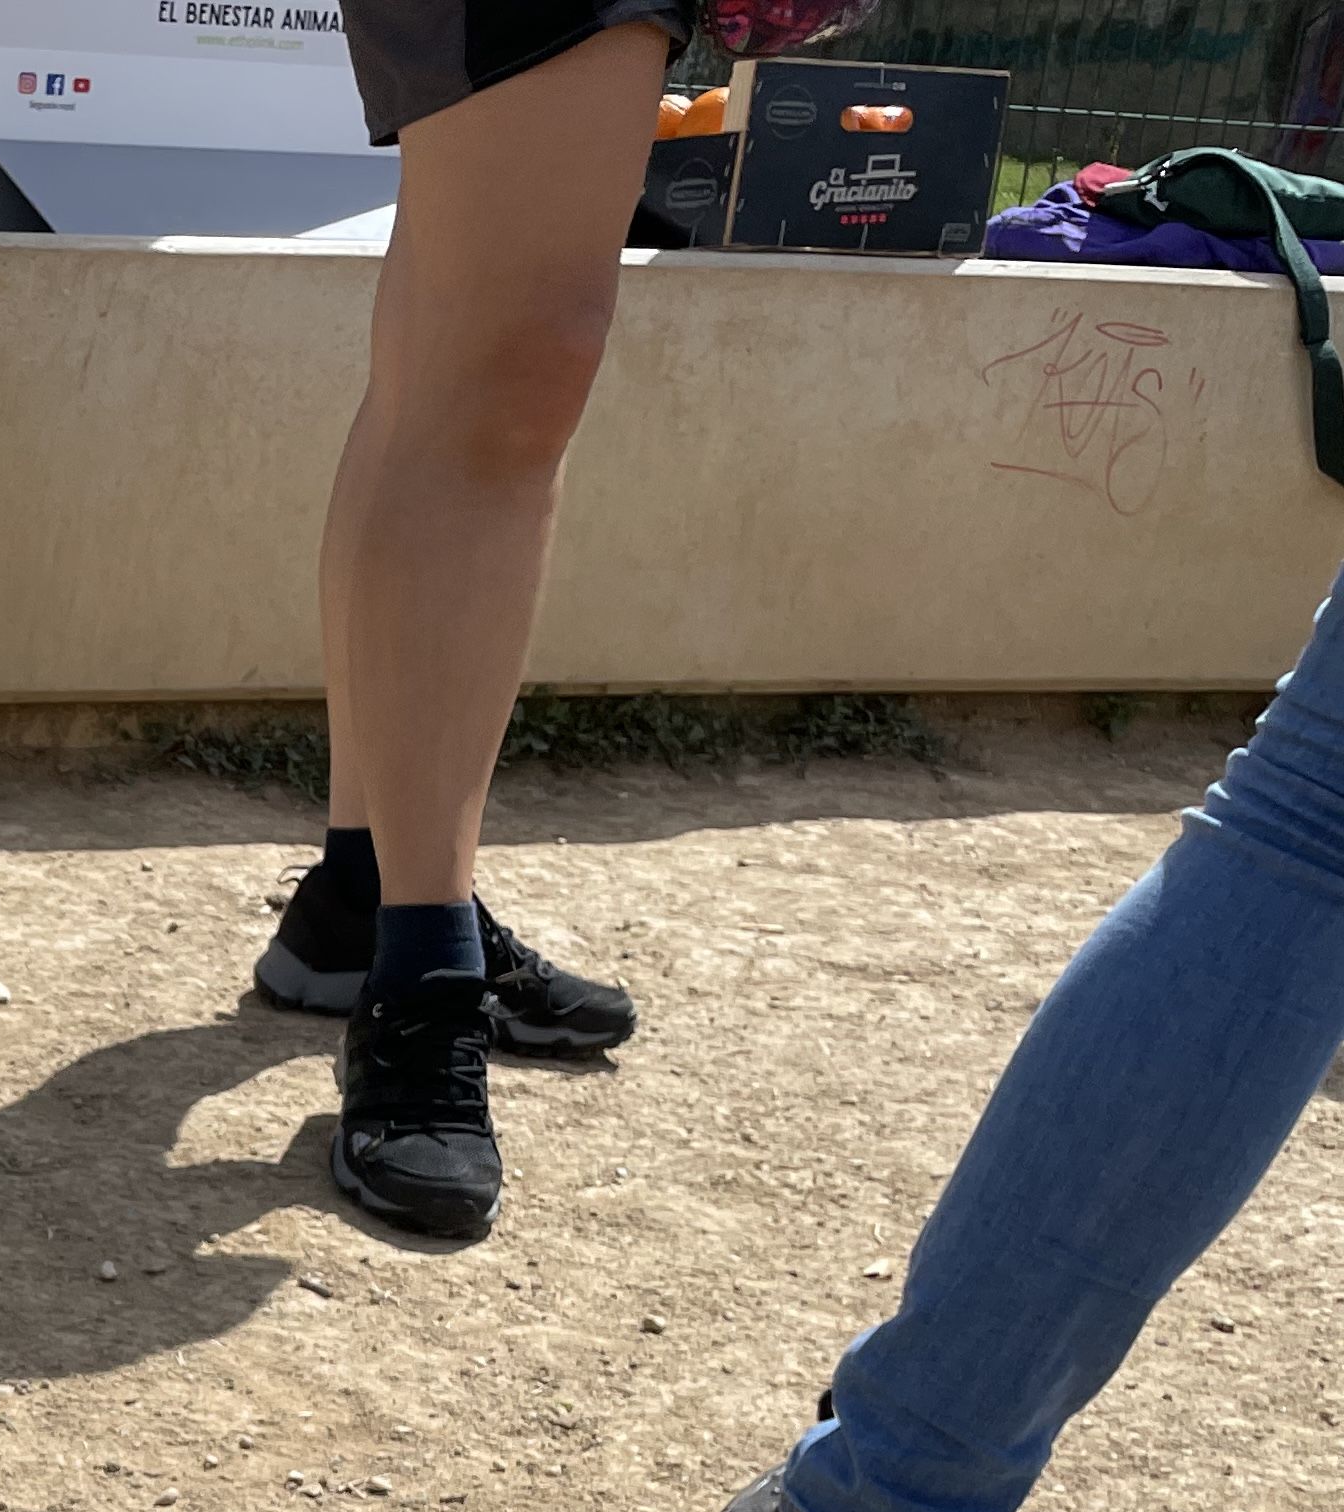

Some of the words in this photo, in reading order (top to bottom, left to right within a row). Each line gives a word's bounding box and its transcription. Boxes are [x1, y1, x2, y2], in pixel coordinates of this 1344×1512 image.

[158, 1, 178, 23] EL
[186, 3, 275, 29] BENESTAR
[809, 179, 918, 211] Gracianito
